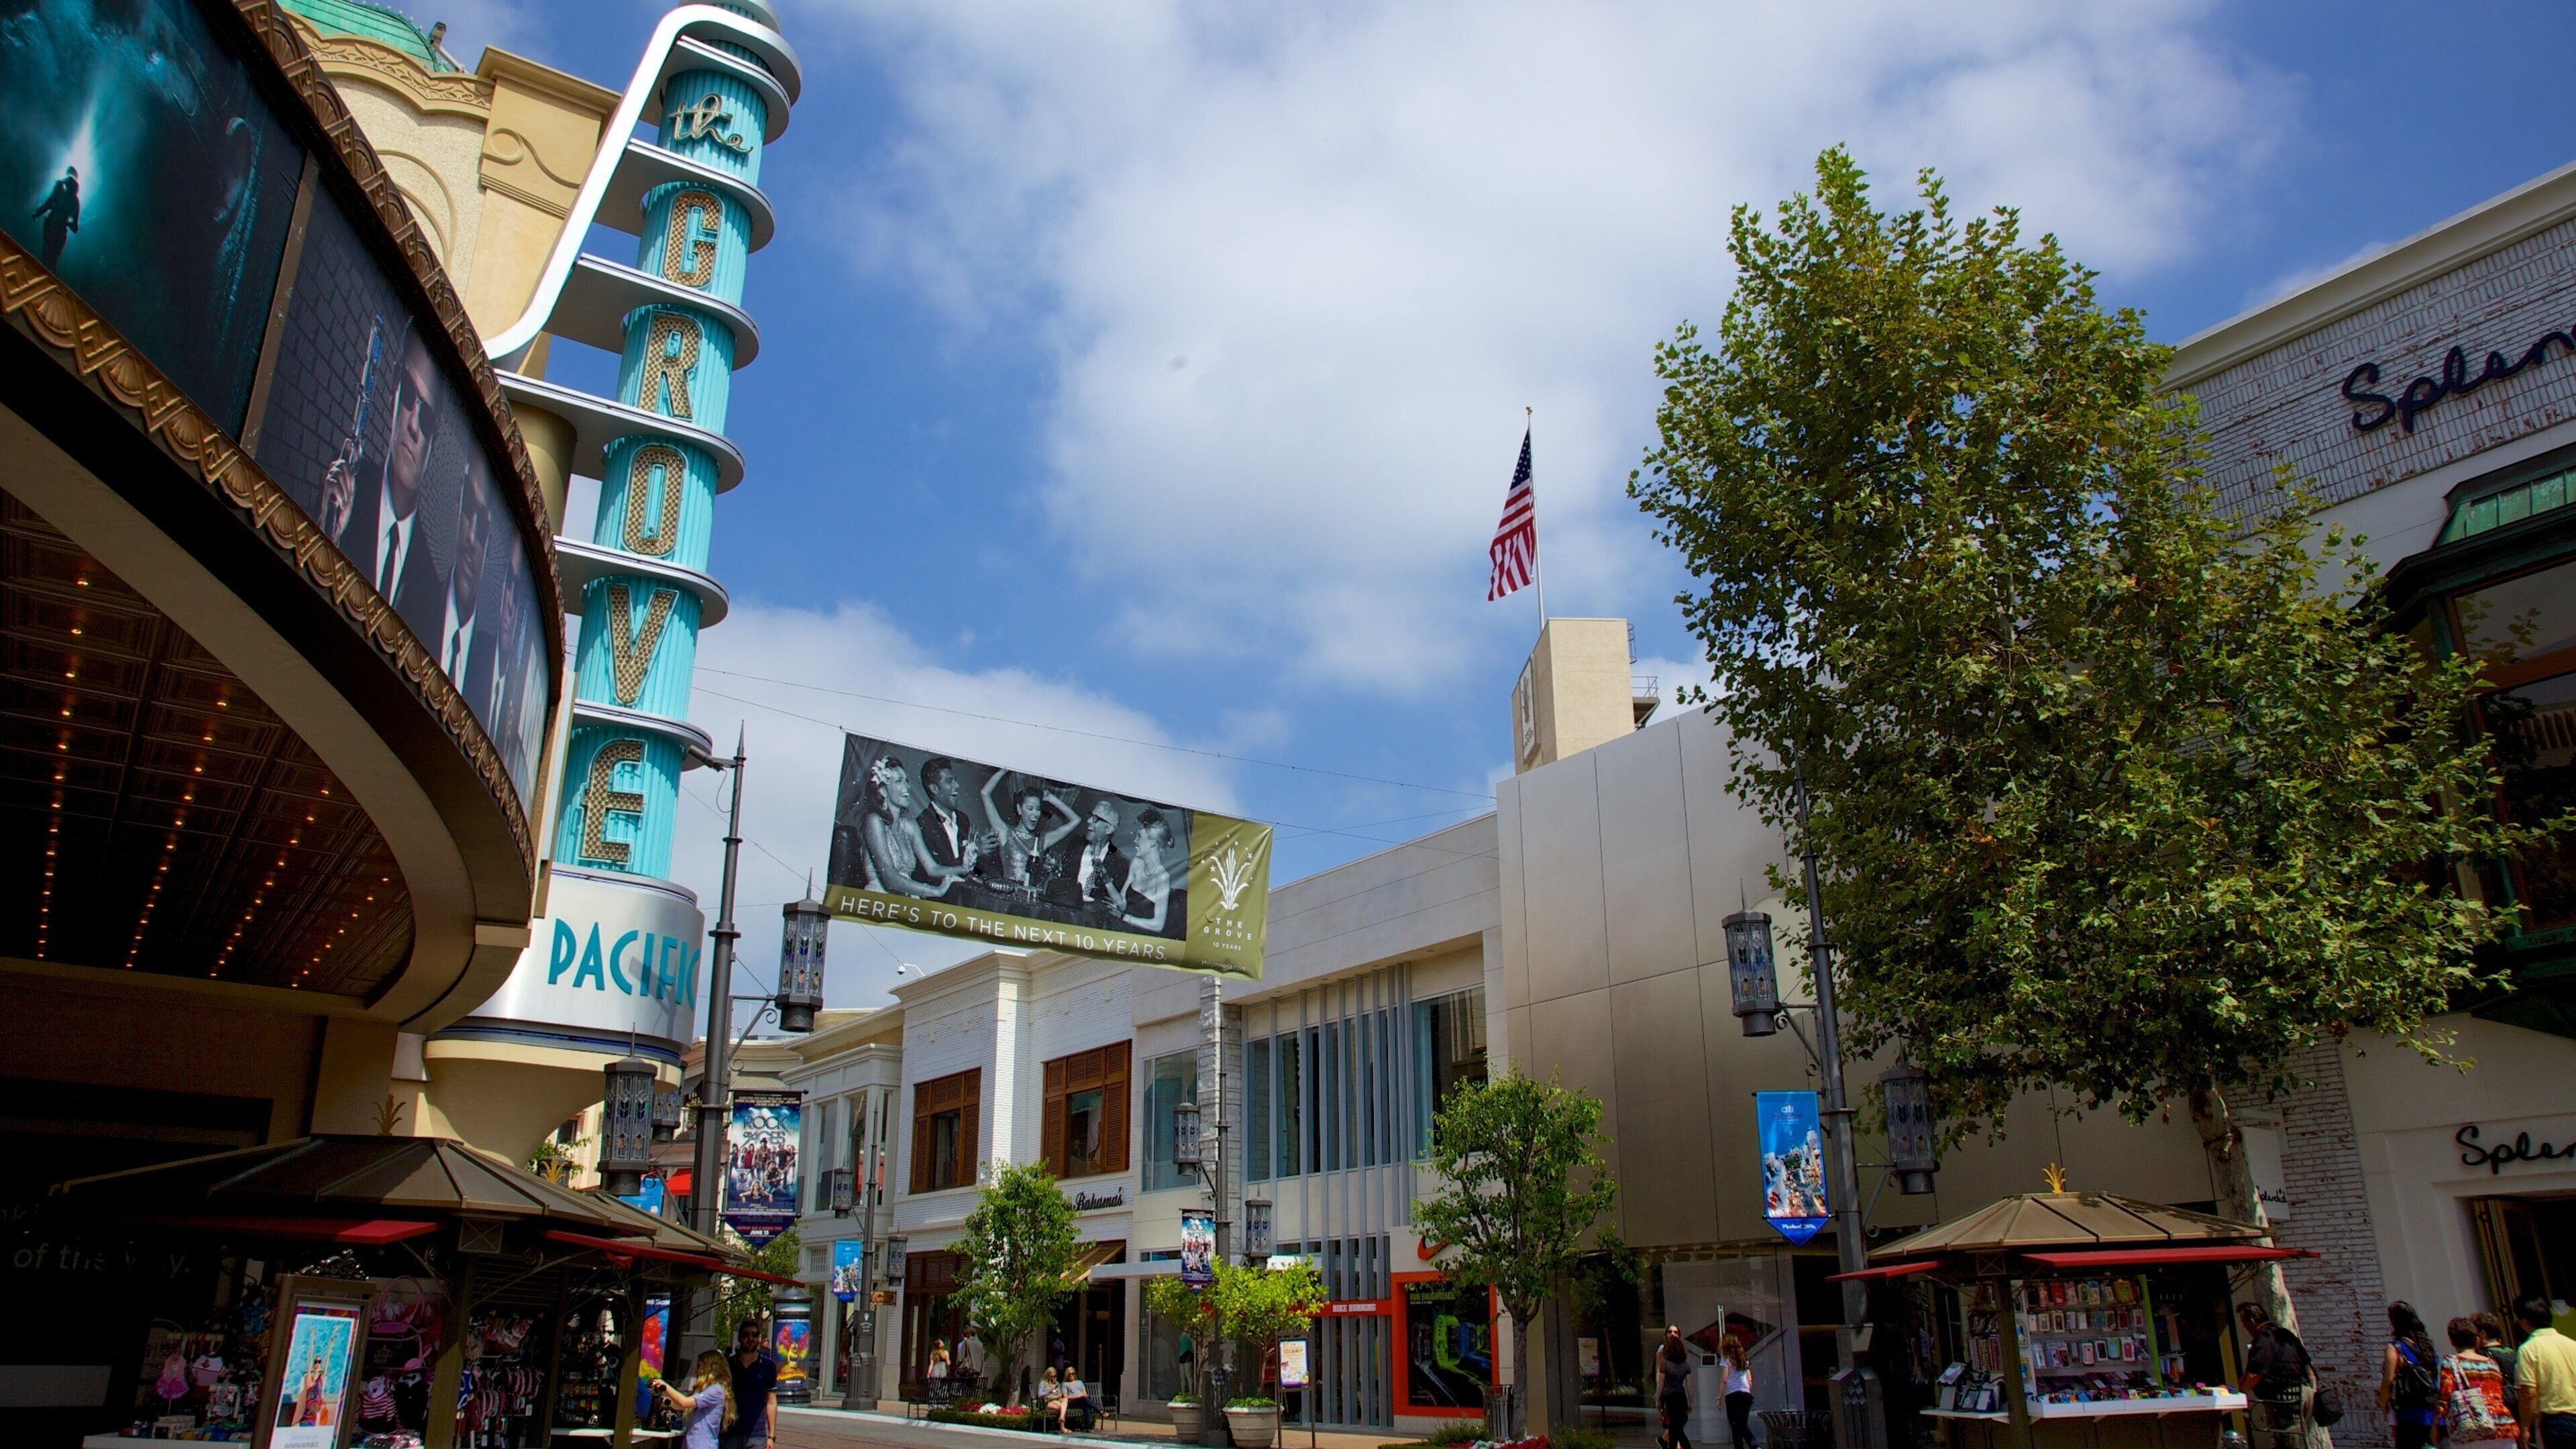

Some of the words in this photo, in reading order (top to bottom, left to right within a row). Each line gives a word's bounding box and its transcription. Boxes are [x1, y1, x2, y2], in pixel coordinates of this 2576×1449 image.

[667, 92, 754, 154] the
[2342, 323, 2576, 433] Splen
[578, 190, 724, 863] GROVE
[840, 896, 920, 923] HERE'S
[930, 910, 957, 929] TO
[967, 916, 1006, 938] THE
[1014, 924, 1067, 946] NEXT
[1075, 934, 1094, 951] 10
[1203, 926, 1252, 941] GROVE
[1216, 918, 1243, 928] THE
[1222, 943, 1242, 951] YEARS
[548, 918, 701, 1012] PACIFIC
[1201, 960, 1246, 972] thegrovela.com
[743, 1116, 792, 1136] ROCK
[740, 1131, 786, 1148] AGES
[1075, 1186, 1123, 1212] Bahama's
[13, 1240, 50, 1270] of
